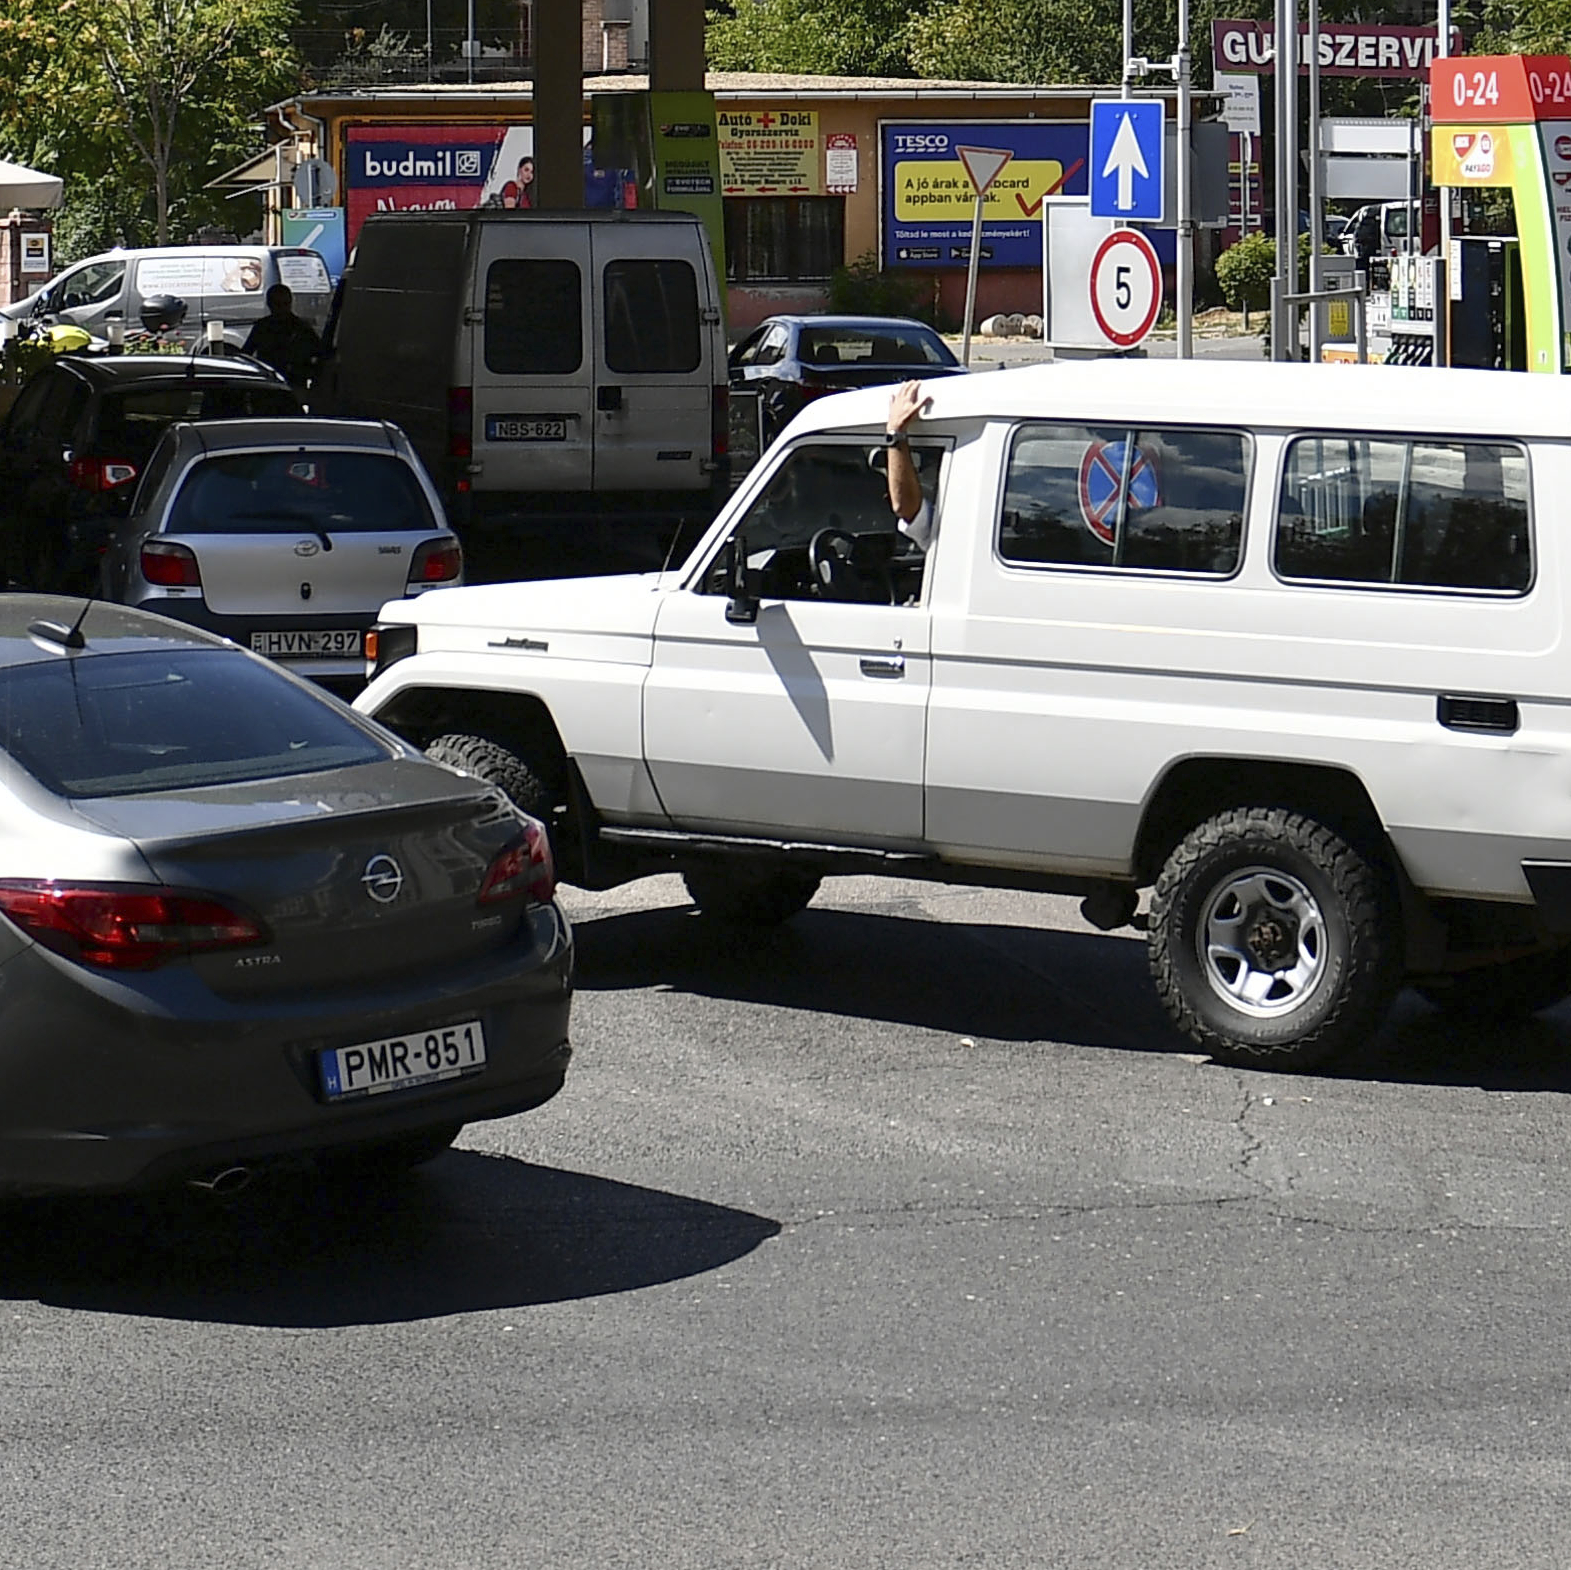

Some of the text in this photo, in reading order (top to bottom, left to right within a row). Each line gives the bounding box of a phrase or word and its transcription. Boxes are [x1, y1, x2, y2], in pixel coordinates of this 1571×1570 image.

[1453, 72, 1498, 106] 0-24
[780, 113, 811, 126] Doki
[894, 135, 948, 147] TESCO
[365, 150, 451, 176] budmil
[905, 179, 913, 188] A
[917, 179, 929, 191] jó
[932, 178, 958, 189] árak
[905, 192, 951, 206] appban
[1114, 265, 1131, 310] 5
[499, 423, 561, 436] NBS-622
[269, 633, 357, 652] HVN-297
[234, 954, 282, 967] ASTRA
[328, 1078, 337, 1088] H
[345, 1028, 476, 1087] PMR-851
